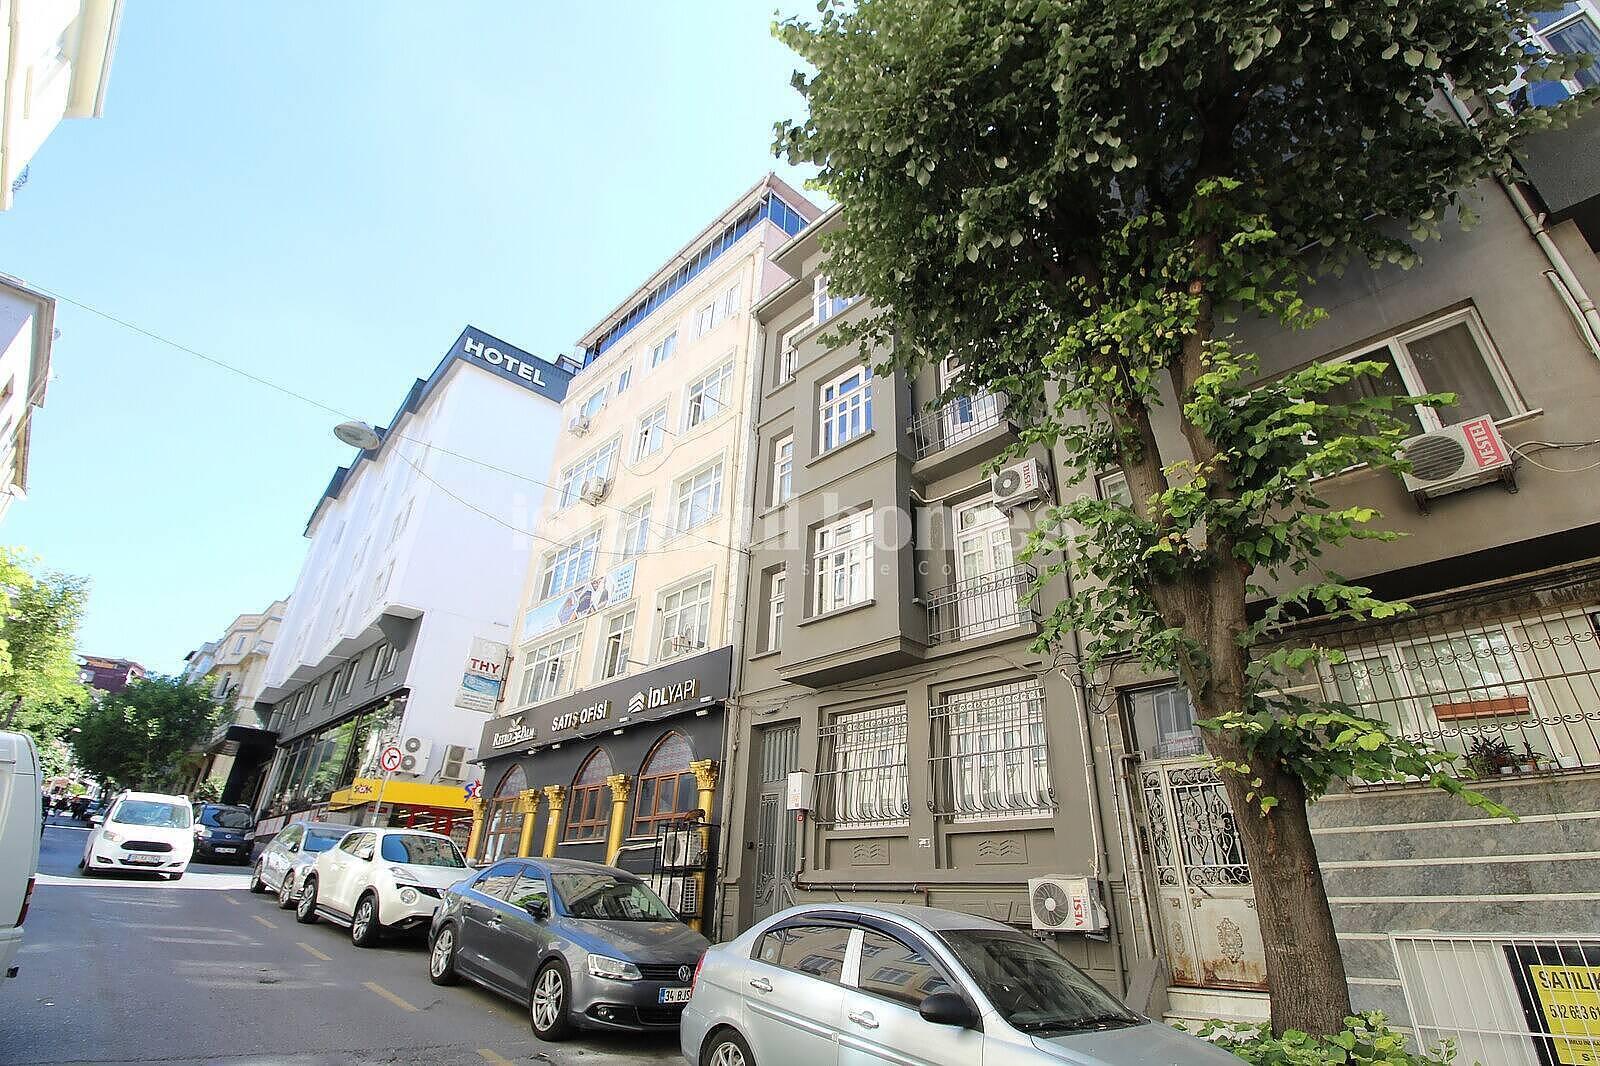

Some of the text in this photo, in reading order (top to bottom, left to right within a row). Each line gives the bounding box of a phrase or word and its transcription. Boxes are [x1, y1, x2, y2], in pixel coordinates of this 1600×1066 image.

[464, 337, 546, 387] HOTEL
[1469, 421, 1498, 465] VESTEL
[470, 658, 500, 674] THY
[665, 990, 674, 1001] 34
